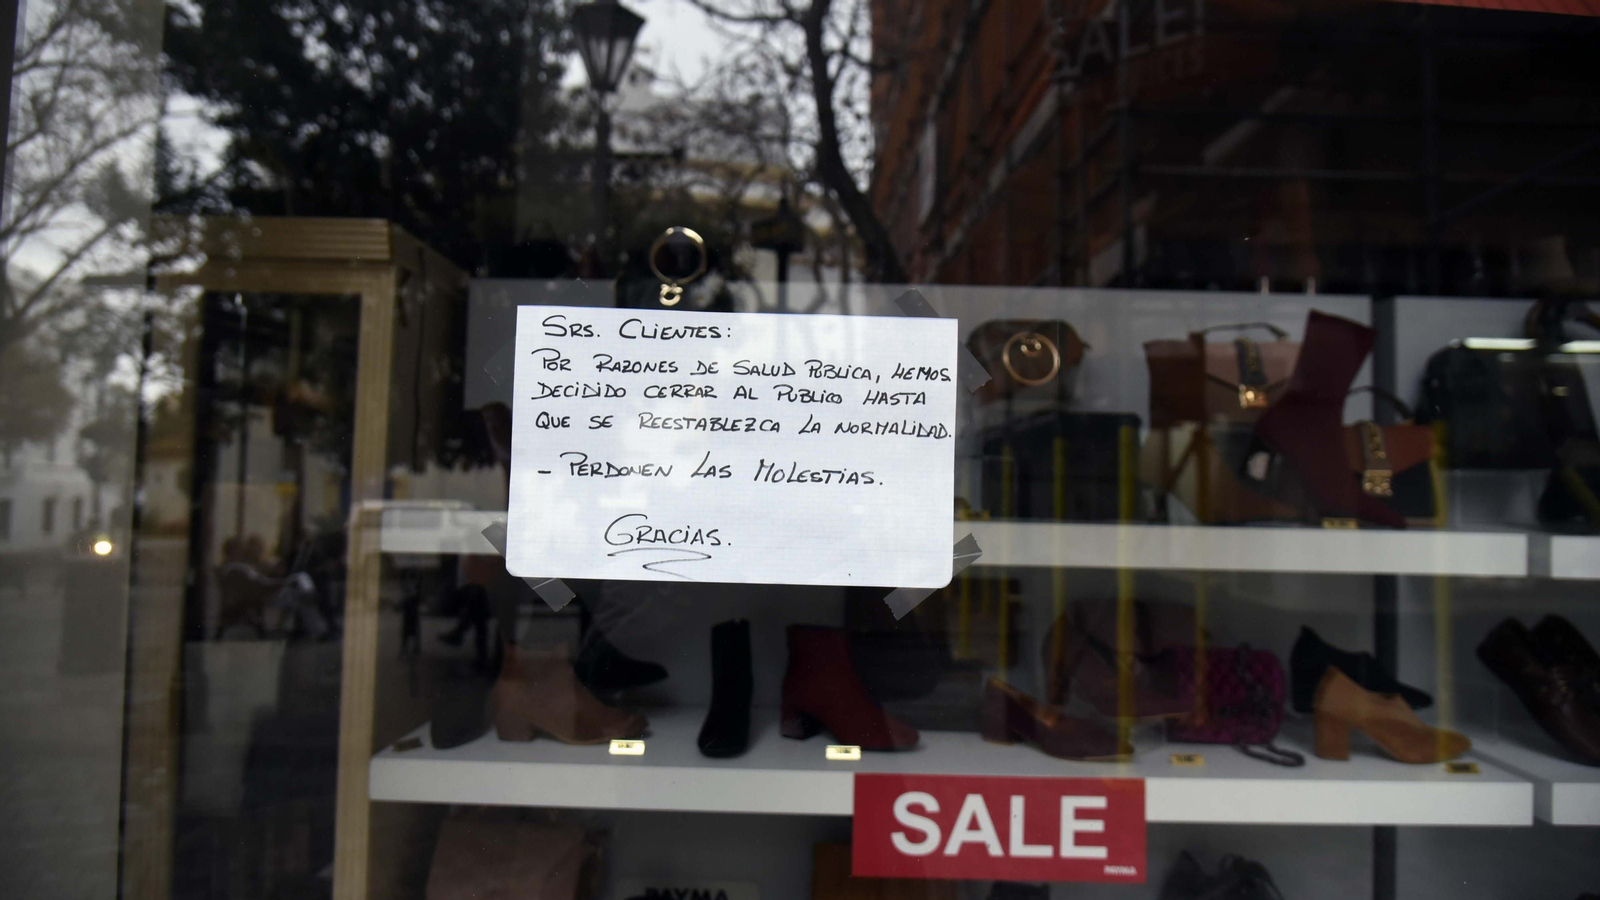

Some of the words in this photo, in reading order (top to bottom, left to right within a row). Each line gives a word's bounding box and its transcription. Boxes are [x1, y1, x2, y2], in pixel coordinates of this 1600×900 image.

[541, 314, 601, 338] SRS.
[618, 317, 731, 341] CLIENTES:
[530, 347, 572, 372] POR
[592, 353, 679, 374] RAZONES
[689, 359, 720, 376] DE
[732, 359, 797, 378] SALUD
[530, 381, 627, 401] DECIDIDO
[643, 383, 718, 400] CERRAR
[732, 384, 759, 401] AL
[862, 389, 926, 407] HASTA
[534, 410, 571, 430] QUE
[587, 414, 615, 430] SE
[637, 411, 781, 434] REESTABLEZCA
[797, 413, 822, 435] LA
[833, 419, 952, 440] NORMALIDAD.
[559, 451, 674, 479] PERDONEN
[690, 450, 733, 479] LAS
[753, 458, 884, 486] MOLESTIAS.
[603, 513, 732, 547] GRACIAS.
[890, 791, 1108, 859] SALE
